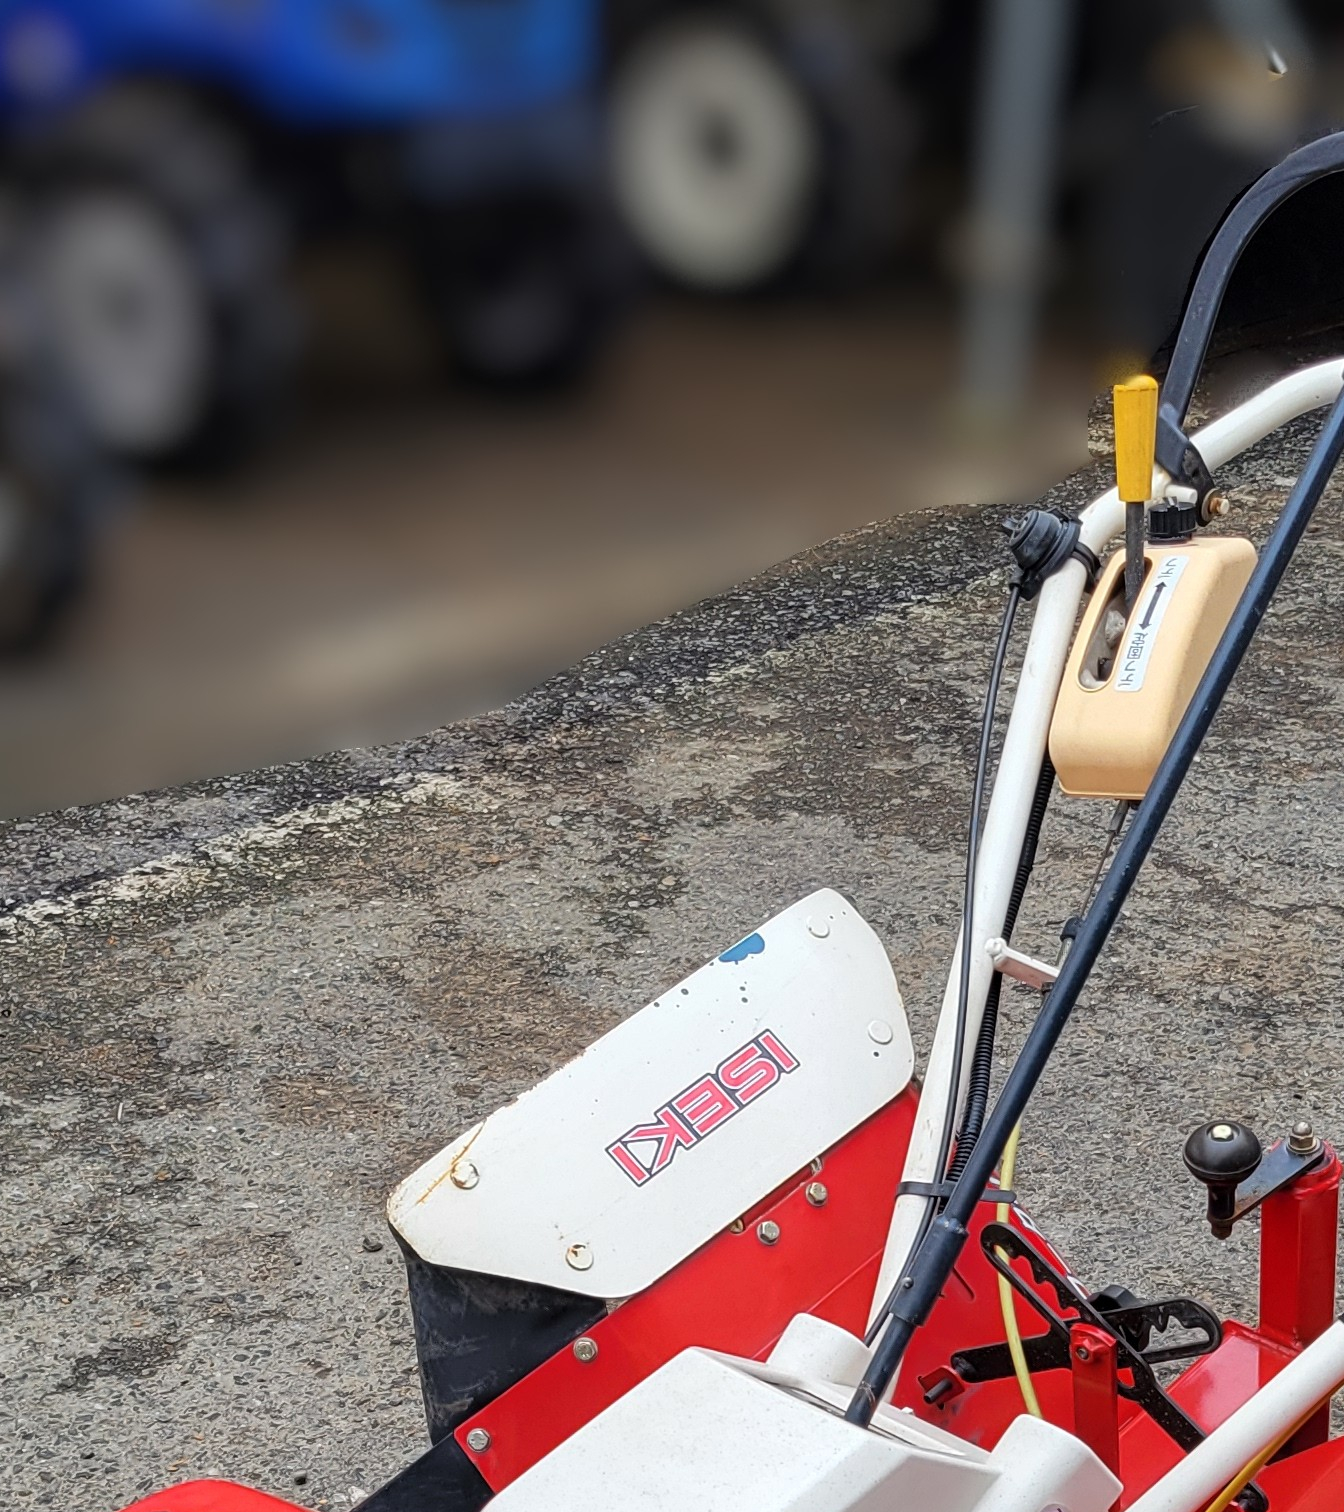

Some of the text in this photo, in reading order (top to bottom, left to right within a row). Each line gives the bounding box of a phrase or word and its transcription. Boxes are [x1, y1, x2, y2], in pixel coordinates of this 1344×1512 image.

[1118, 633, 1148, 686] デフ固定
[605, 1028, 801, 1187] ISEKI
